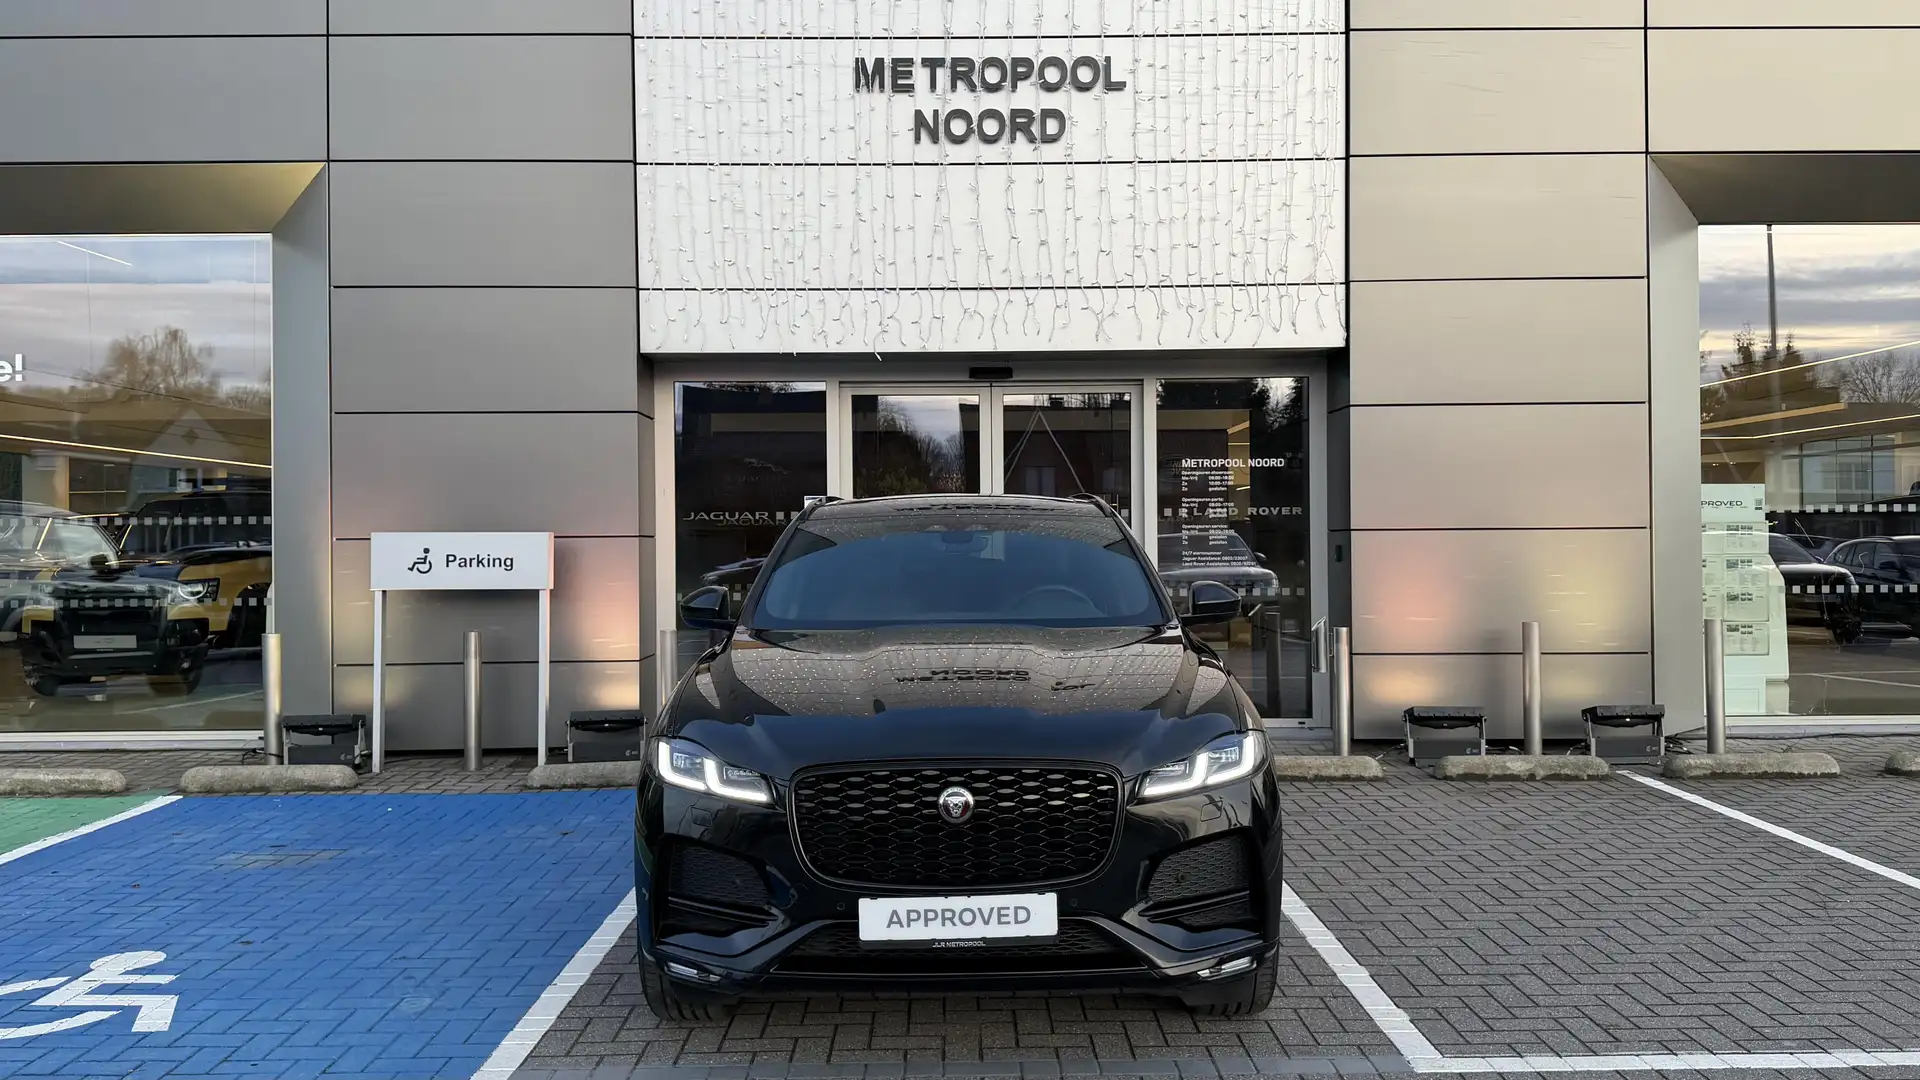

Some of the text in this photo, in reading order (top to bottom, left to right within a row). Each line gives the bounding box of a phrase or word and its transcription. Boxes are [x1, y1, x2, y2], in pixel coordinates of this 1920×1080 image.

[854, 55, 1127, 93] METROPOOL
[914, 107, 1067, 144] NOORD
[1181, 458, 1246, 468] METROPOOL
[1248, 458, 1285, 467] NOORD
[682, 511, 769, 520] JAGUAR
[1247, 506, 1303, 515] ROVER
[445, 553, 514, 572] Parking
[886, 905, 1031, 929] APPROVED
[946, 940, 987, 948] METROPOOL
